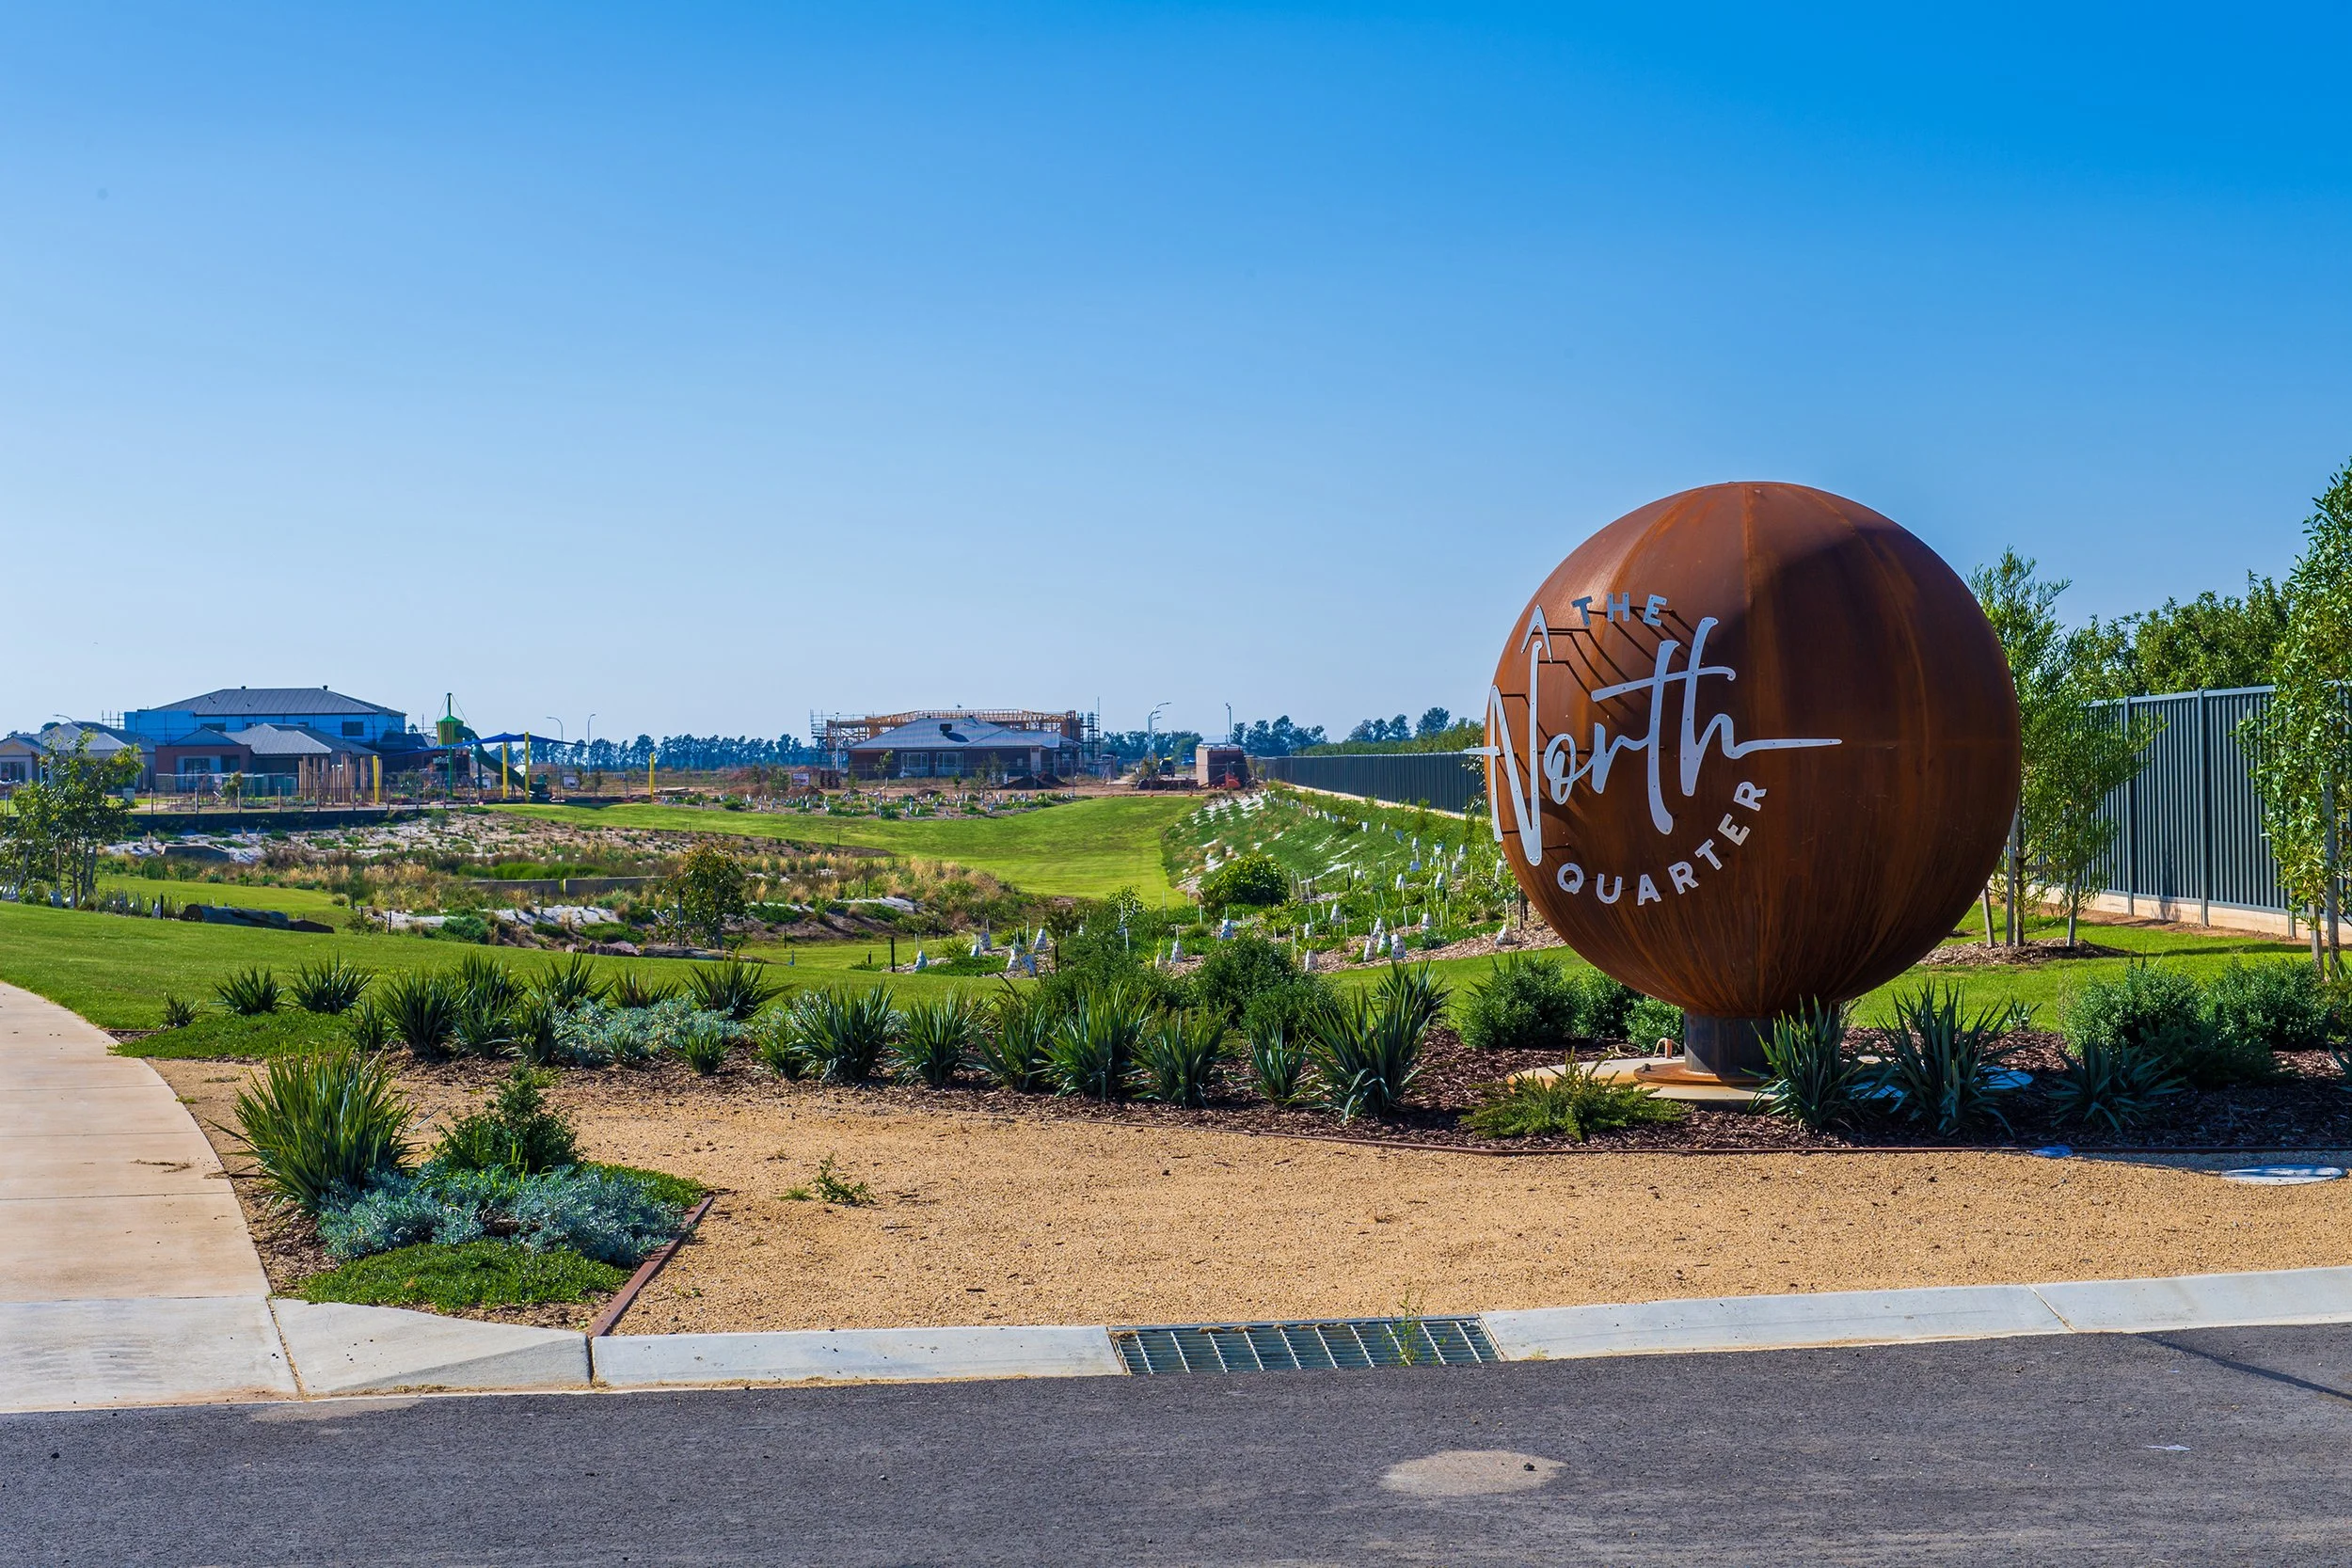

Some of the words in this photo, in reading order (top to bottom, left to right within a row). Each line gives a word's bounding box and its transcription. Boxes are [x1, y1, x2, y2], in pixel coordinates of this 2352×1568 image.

[1570, 592, 1668, 627] THE
[1486, 616, 1843, 866] North
[1556, 781, 1768, 907] QUARTER
